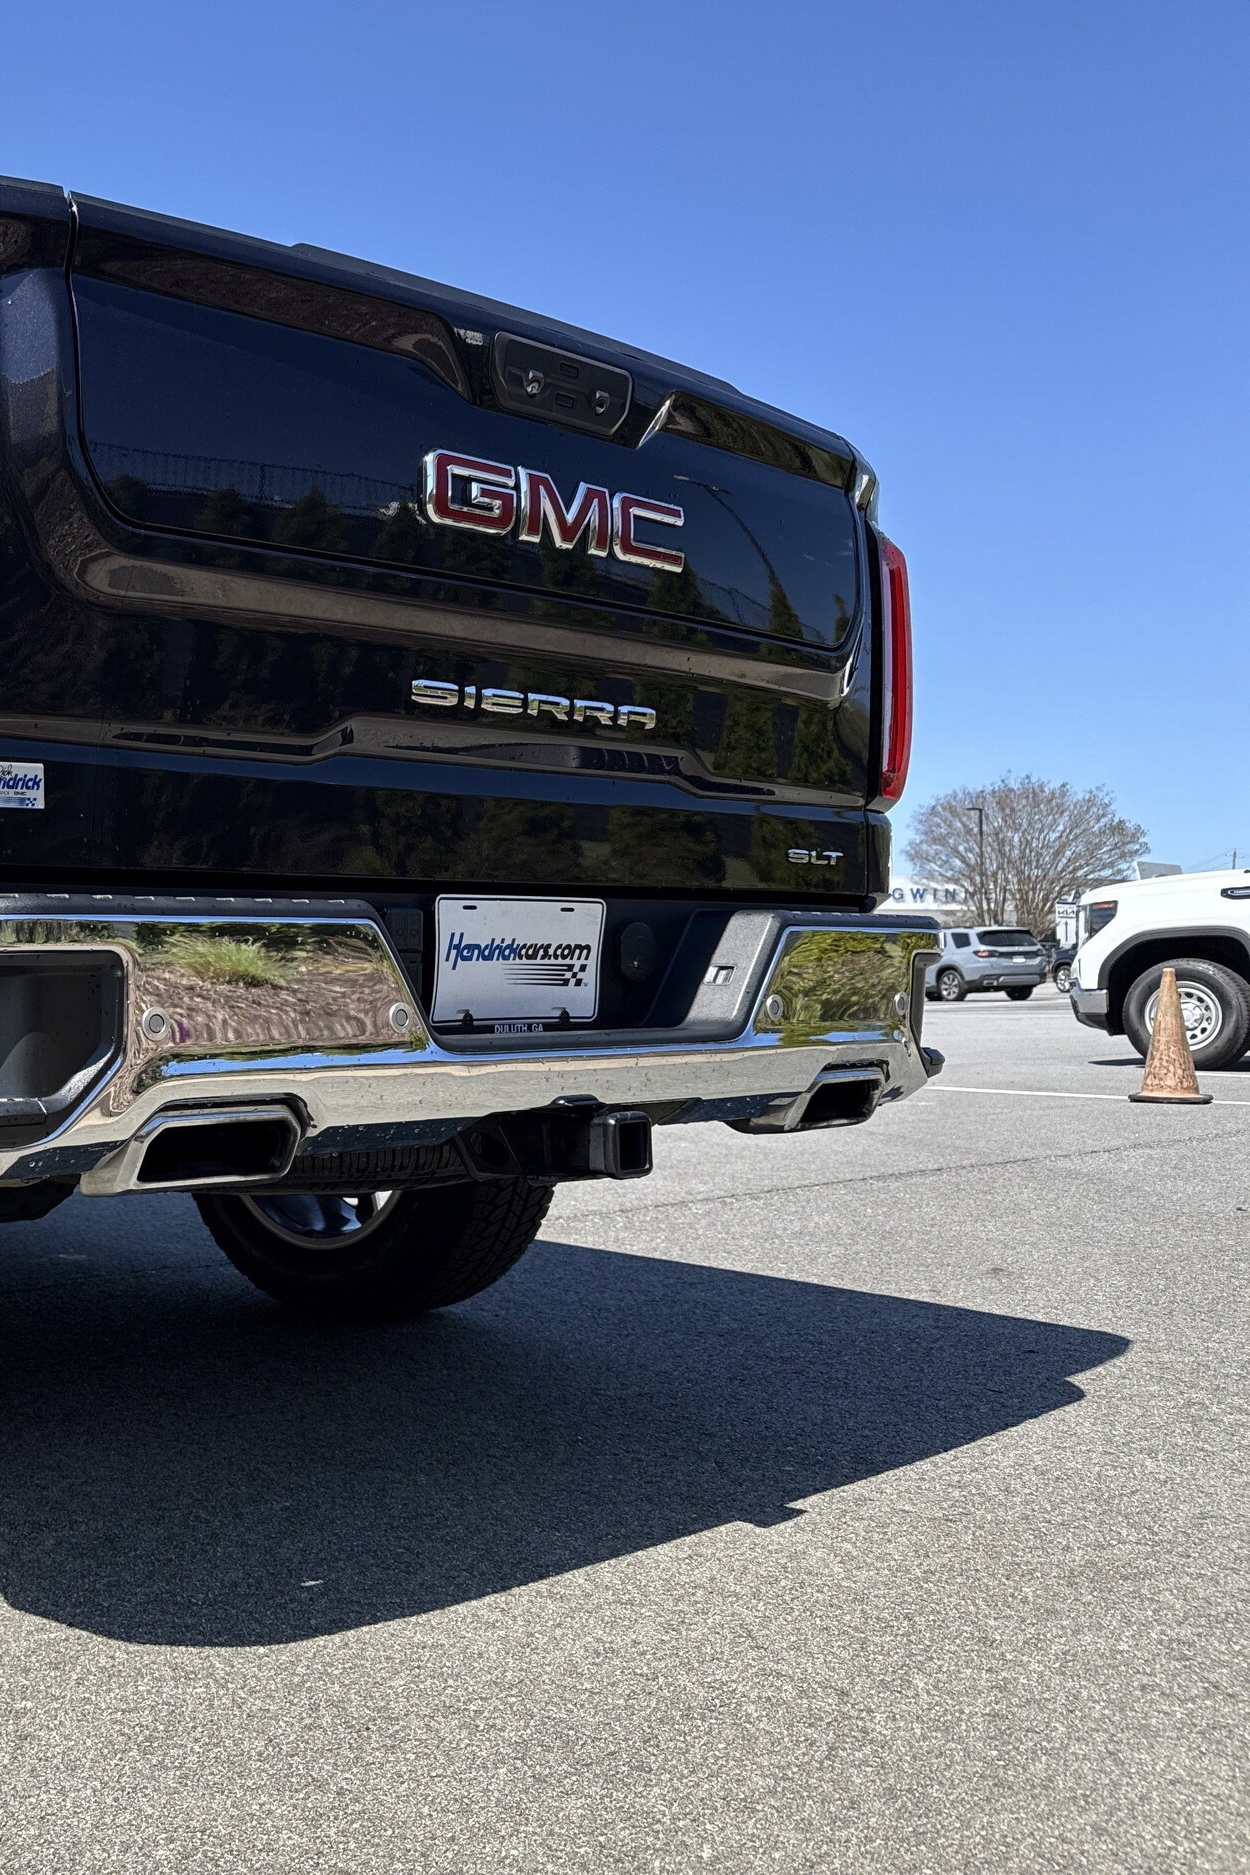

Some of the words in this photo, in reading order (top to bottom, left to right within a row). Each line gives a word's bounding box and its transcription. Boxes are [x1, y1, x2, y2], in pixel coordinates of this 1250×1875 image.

[420, 448, 685, 573] GMC
[411, 679, 657, 730] SIERRA
[788, 849, 844, 865] SLT
[445, 932, 591, 970] Hendrickcars.com
[531, 1023, 544, 1033] GA
